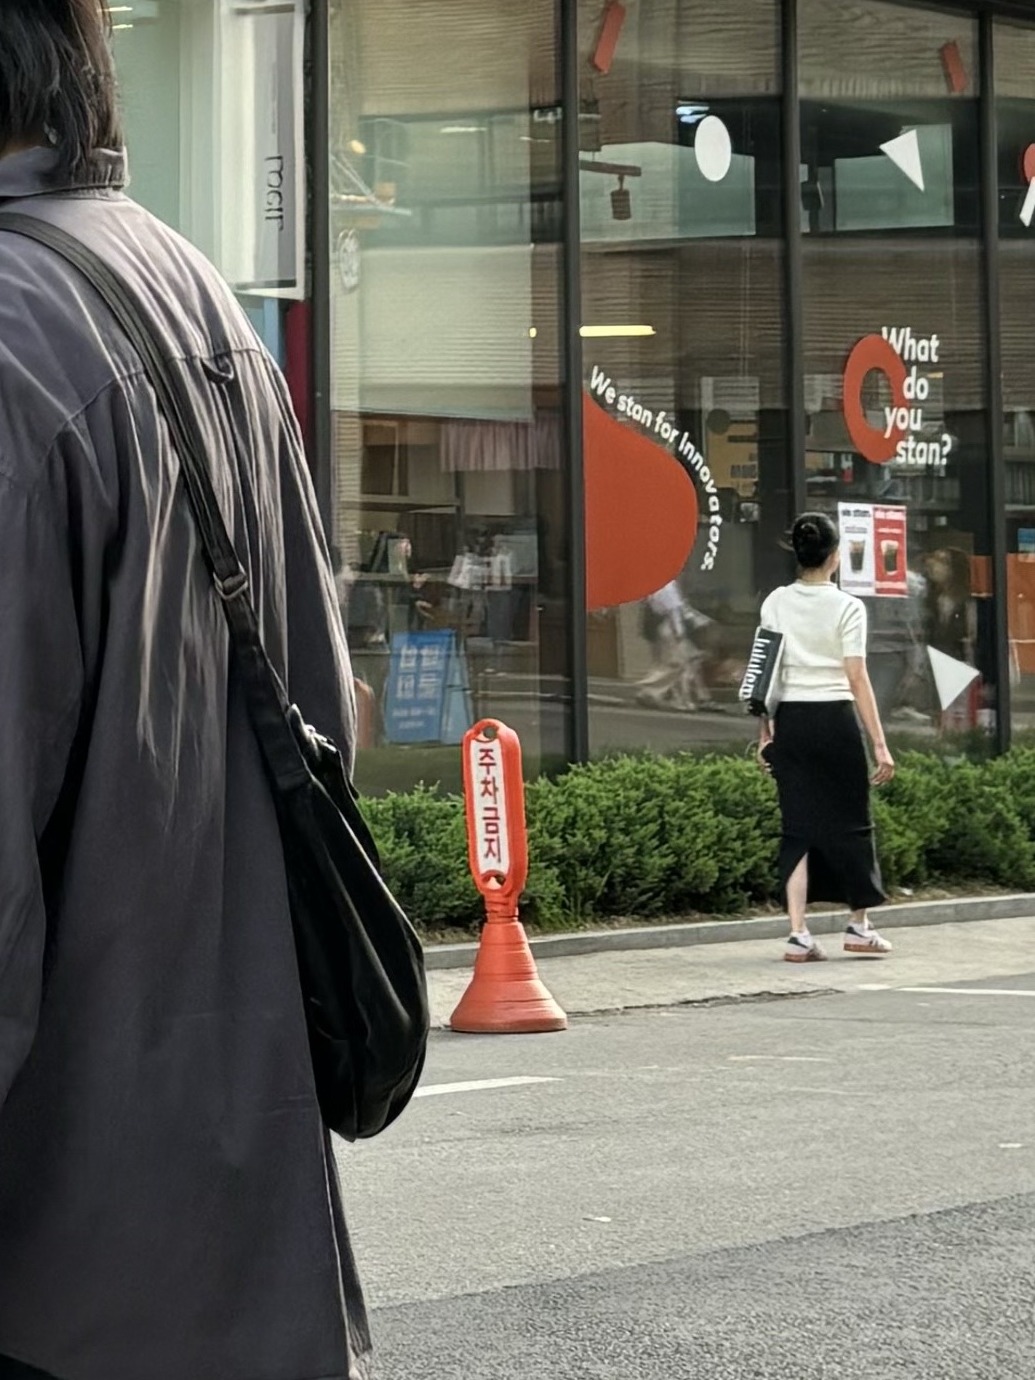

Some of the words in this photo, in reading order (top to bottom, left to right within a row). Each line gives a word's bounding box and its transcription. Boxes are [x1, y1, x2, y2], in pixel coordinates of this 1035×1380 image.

[881, 326, 940, 362] What
[902, 365, 929, 400] do
[590, 365, 616, 404] We
[617, 394, 653, 428] stan
[654, 411, 680, 442] for
[883, 406, 922, 439] you
[895, 433, 952, 465] stan?
[478, 748, 502, 863] 주차금지
